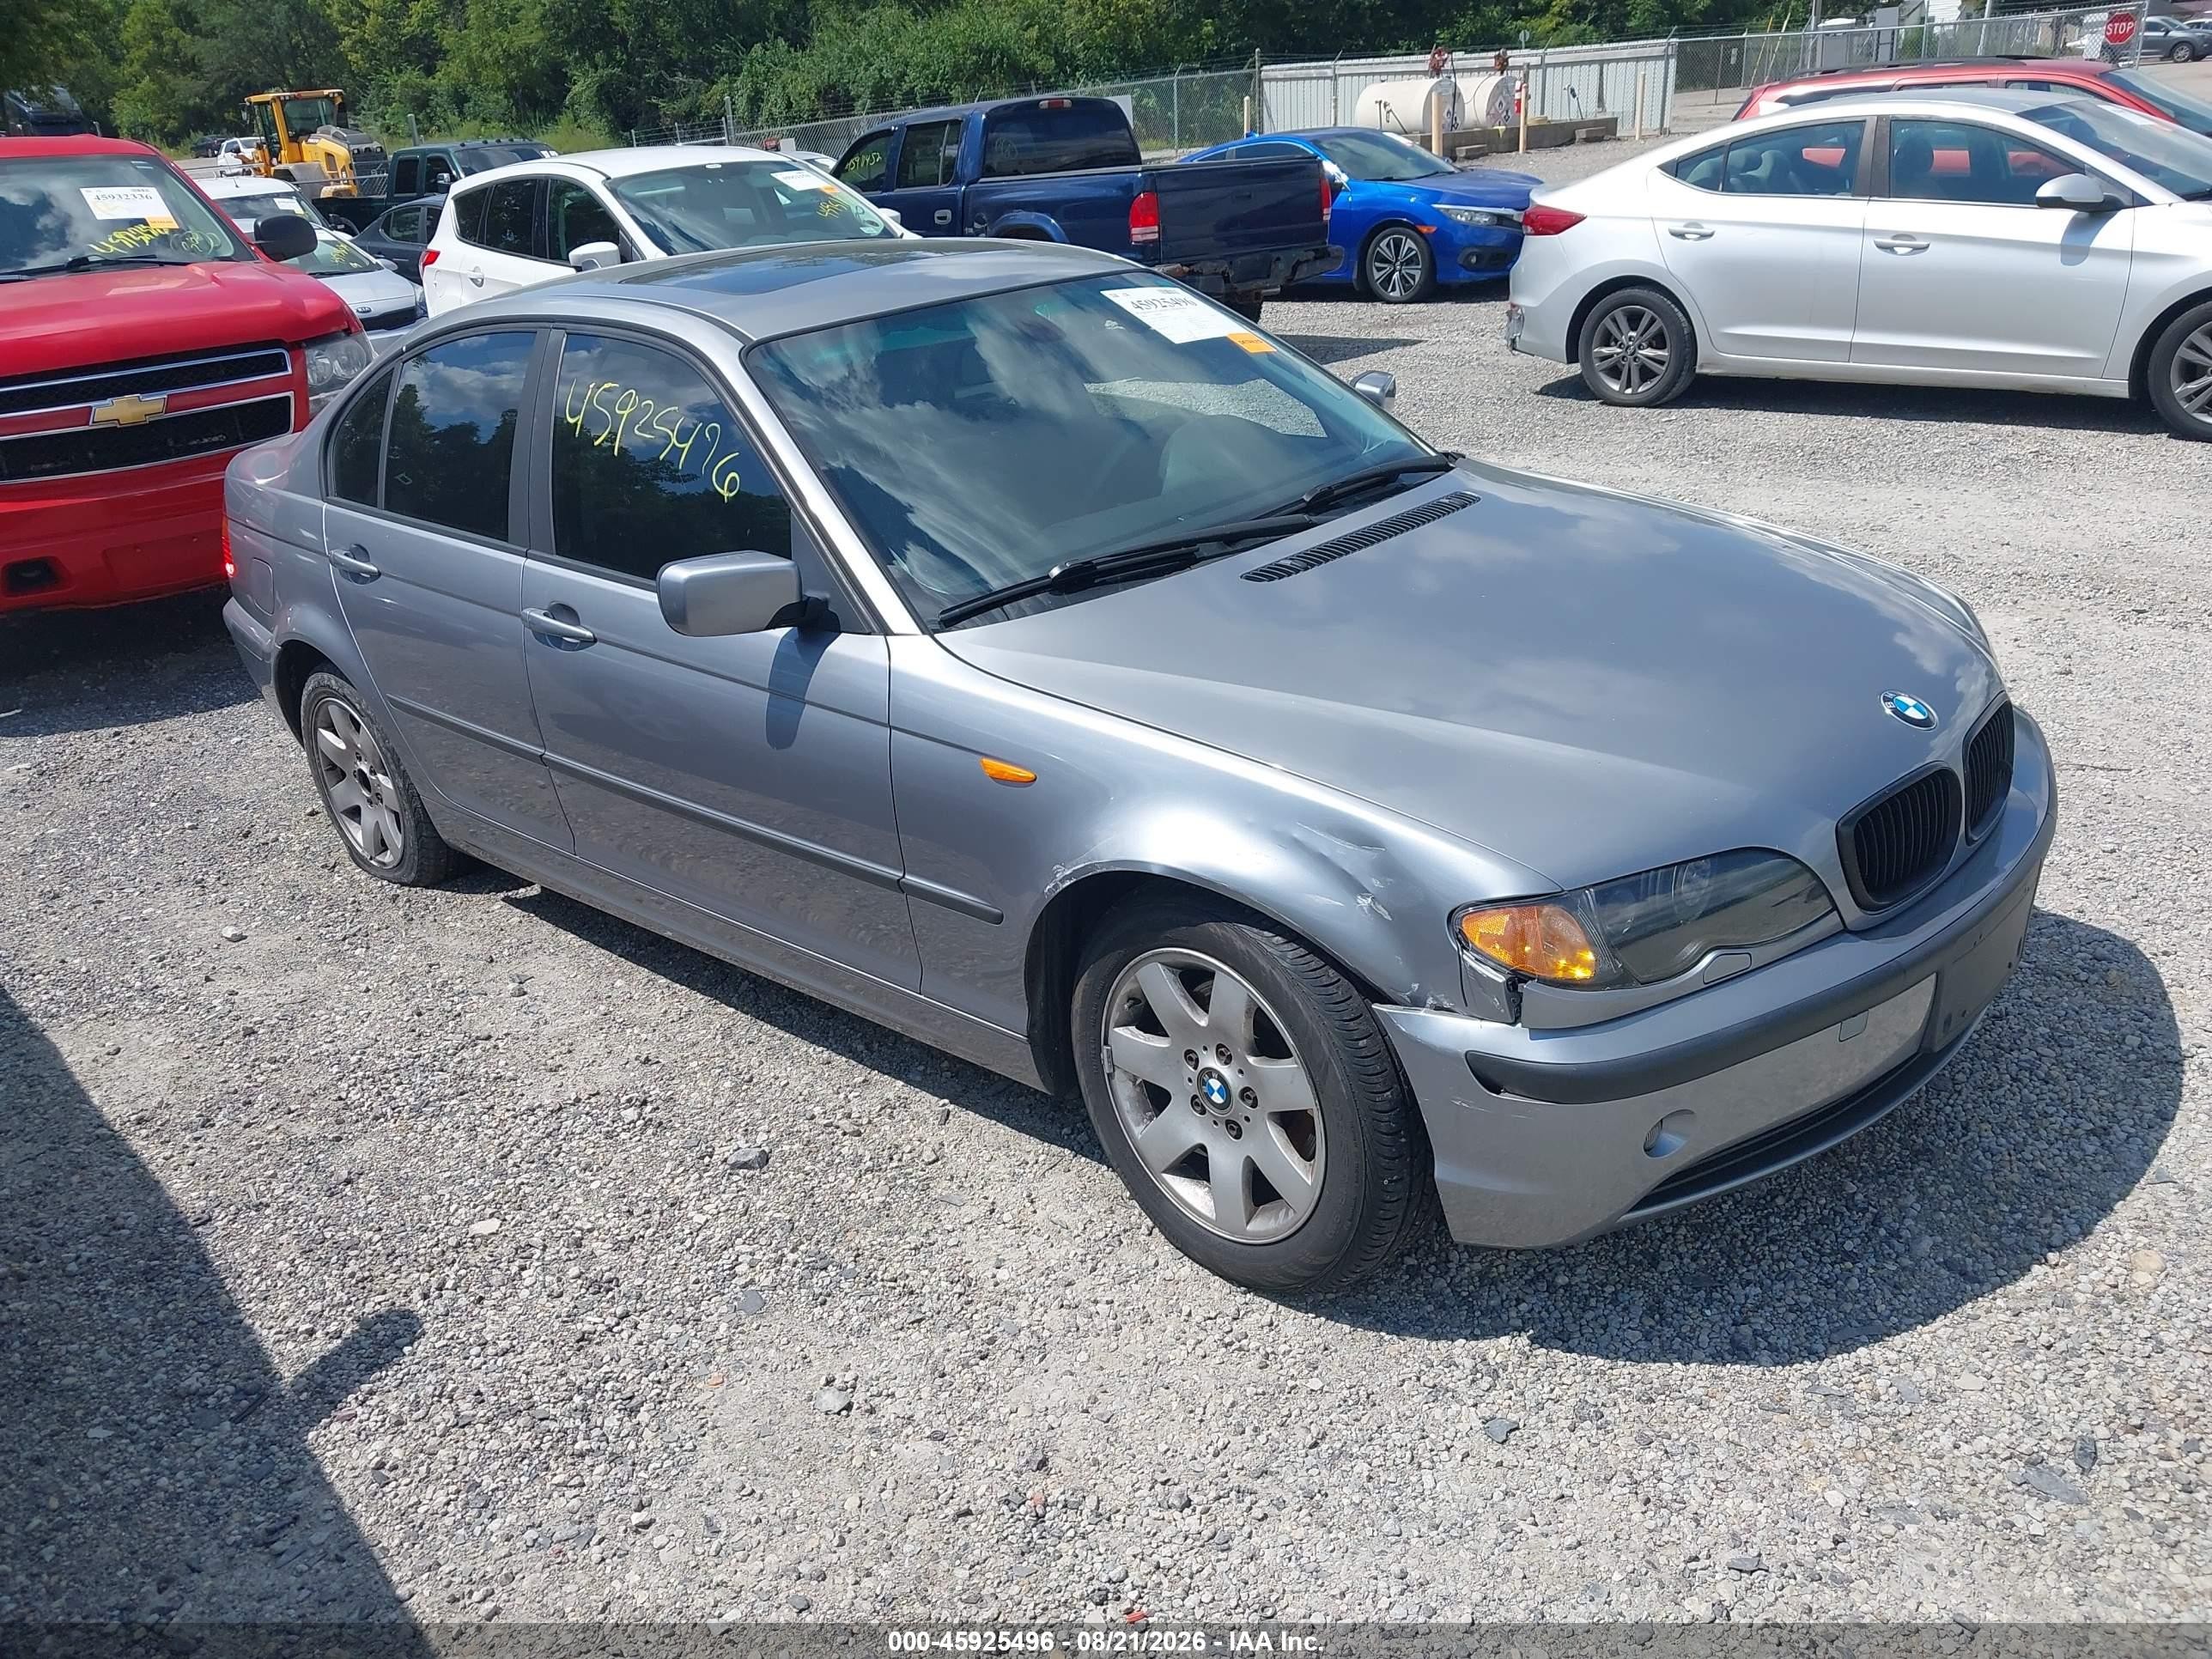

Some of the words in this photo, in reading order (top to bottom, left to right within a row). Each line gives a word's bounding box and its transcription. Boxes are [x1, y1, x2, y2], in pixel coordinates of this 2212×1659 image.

[2106, 21, 2134, 35] STOP
[1130, 297, 1197, 311] 45925496
[1201, 1071, 1218, 1093] BMW
